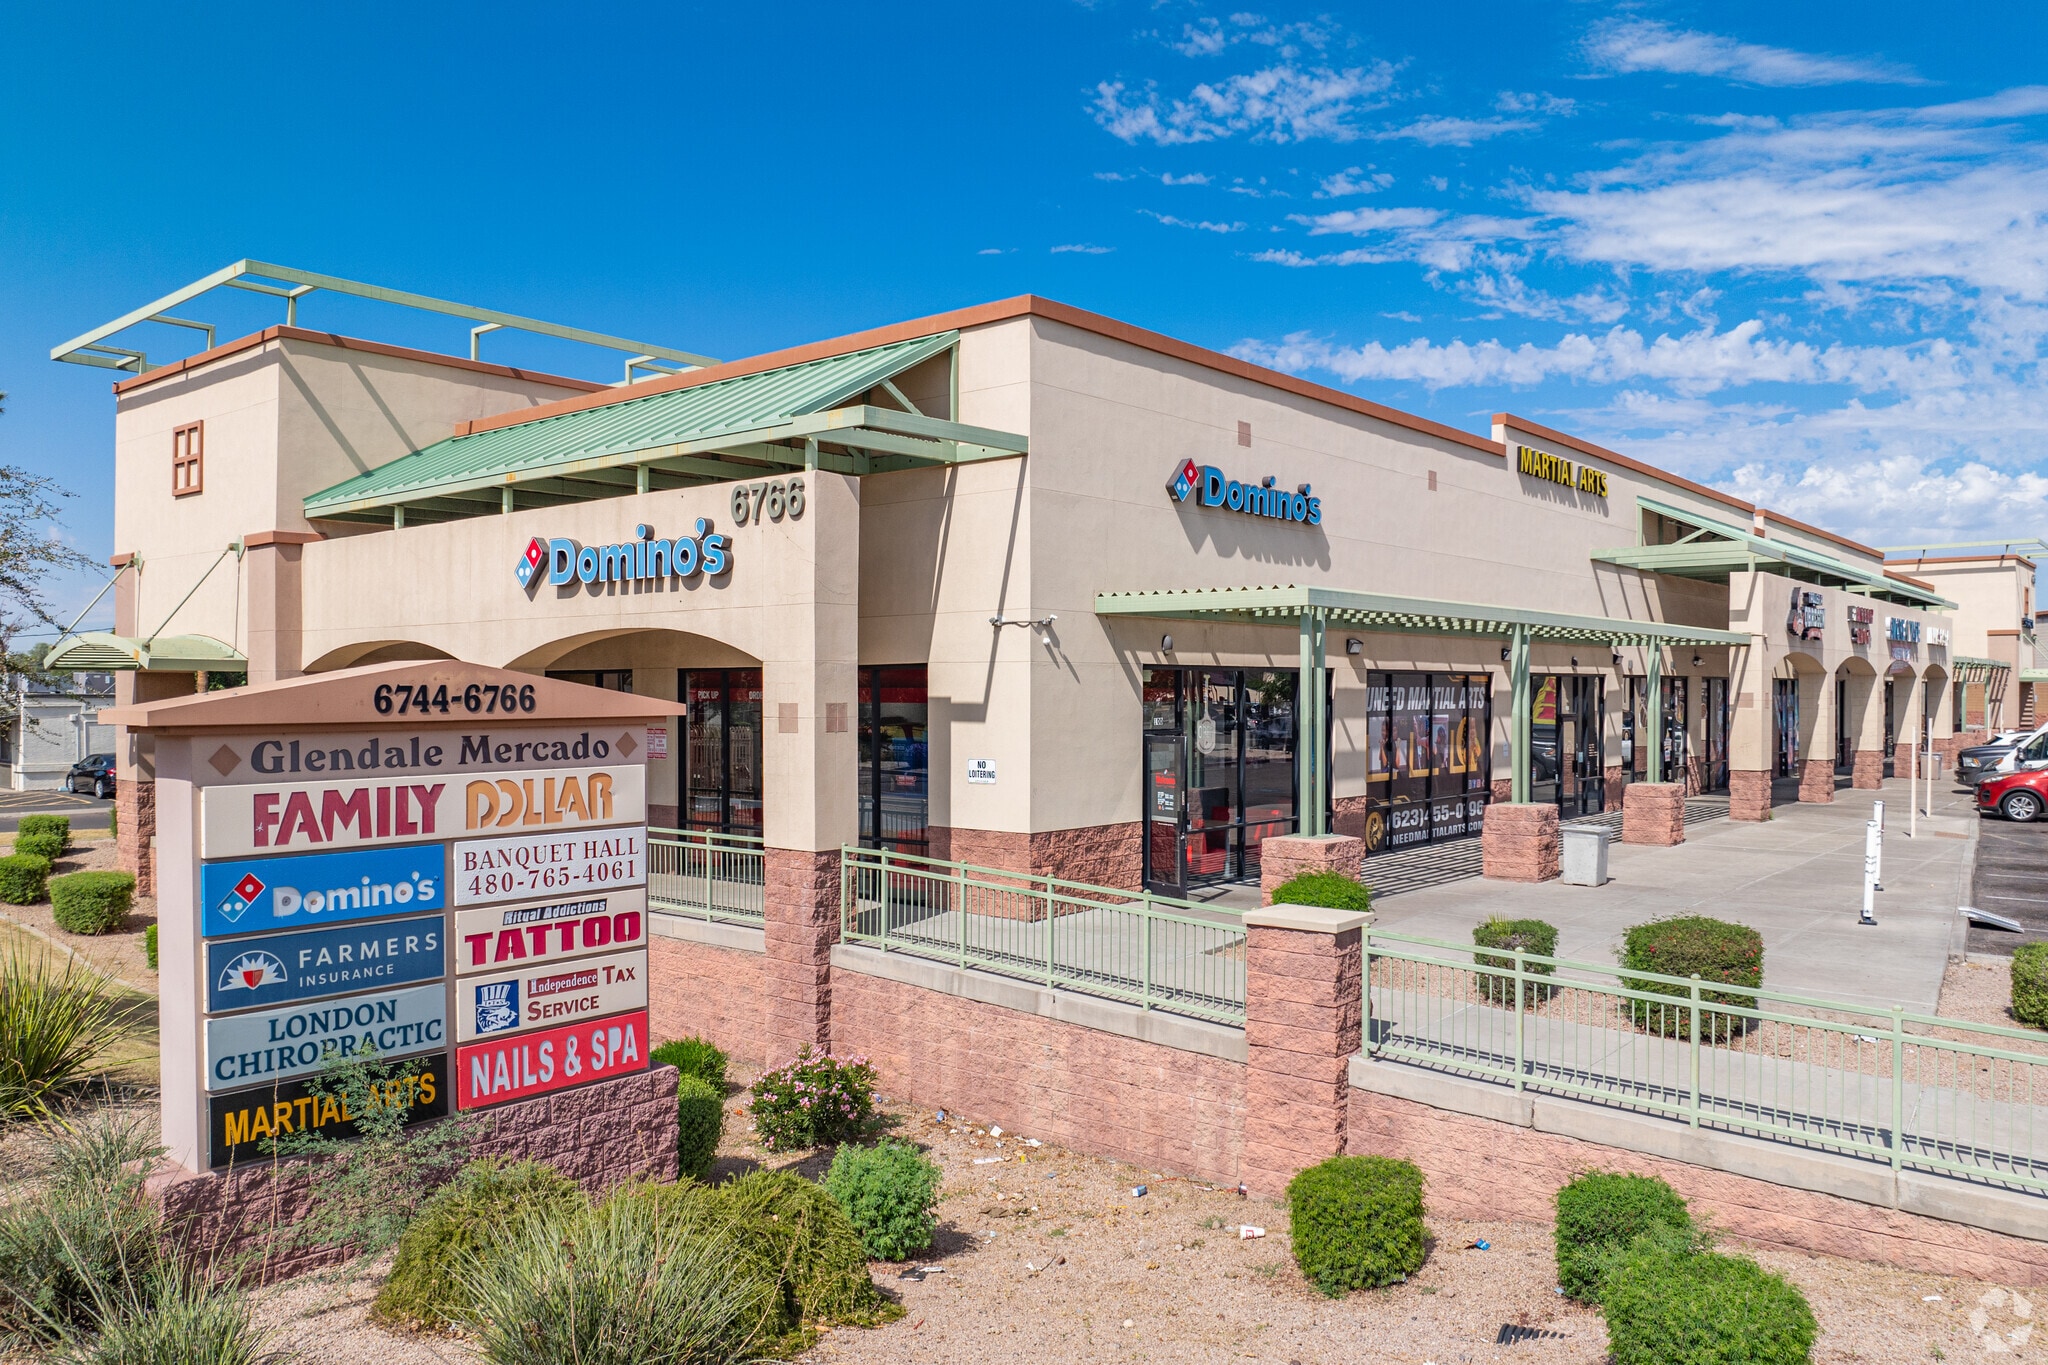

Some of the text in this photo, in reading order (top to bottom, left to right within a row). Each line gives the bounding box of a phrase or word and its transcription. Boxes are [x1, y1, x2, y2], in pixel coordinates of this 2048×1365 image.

[1519, 445, 1608, 497] MARTIAL ARTS
[731, 477, 806, 524] 6766
[1203, 465, 1322, 525] Domino's
[549, 517, 730, 587] Domino's
[374, 684, 536, 714] 6744-6766
[697, 690, 719, 699] PICK UP
[1407, 686, 1456, 710] MATIAL
[251, 736, 443, 774] Glendale
[458, 732, 610, 766] Mercado
[977, 761, 986, 769] NO
[968, 770, 995, 779] LOITERING
[253, 772, 614, 848] FAMILY DOLLAR
[464, 837, 639, 871] BANQUET HALL
[273, 870, 435, 917] Domino's
[468, 860, 636, 895] 480-765-4061
[503, 901, 607, 925] Ritual Addictions
[299, 932, 438, 968] FARMERS
[464, 911, 641, 966] TATTOO
[300, 964, 394, 987] INSURANCE
[529, 973, 598, 994] Independence
[268, 999, 397, 1042] LONDON
[527, 995, 600, 1022] SERVICE
[215, 1019, 442, 1081] CHIROPRACTIC
[471, 1023, 639, 1098] NAILS & SPA
[224, 1090, 354, 1147] MARTIAL
